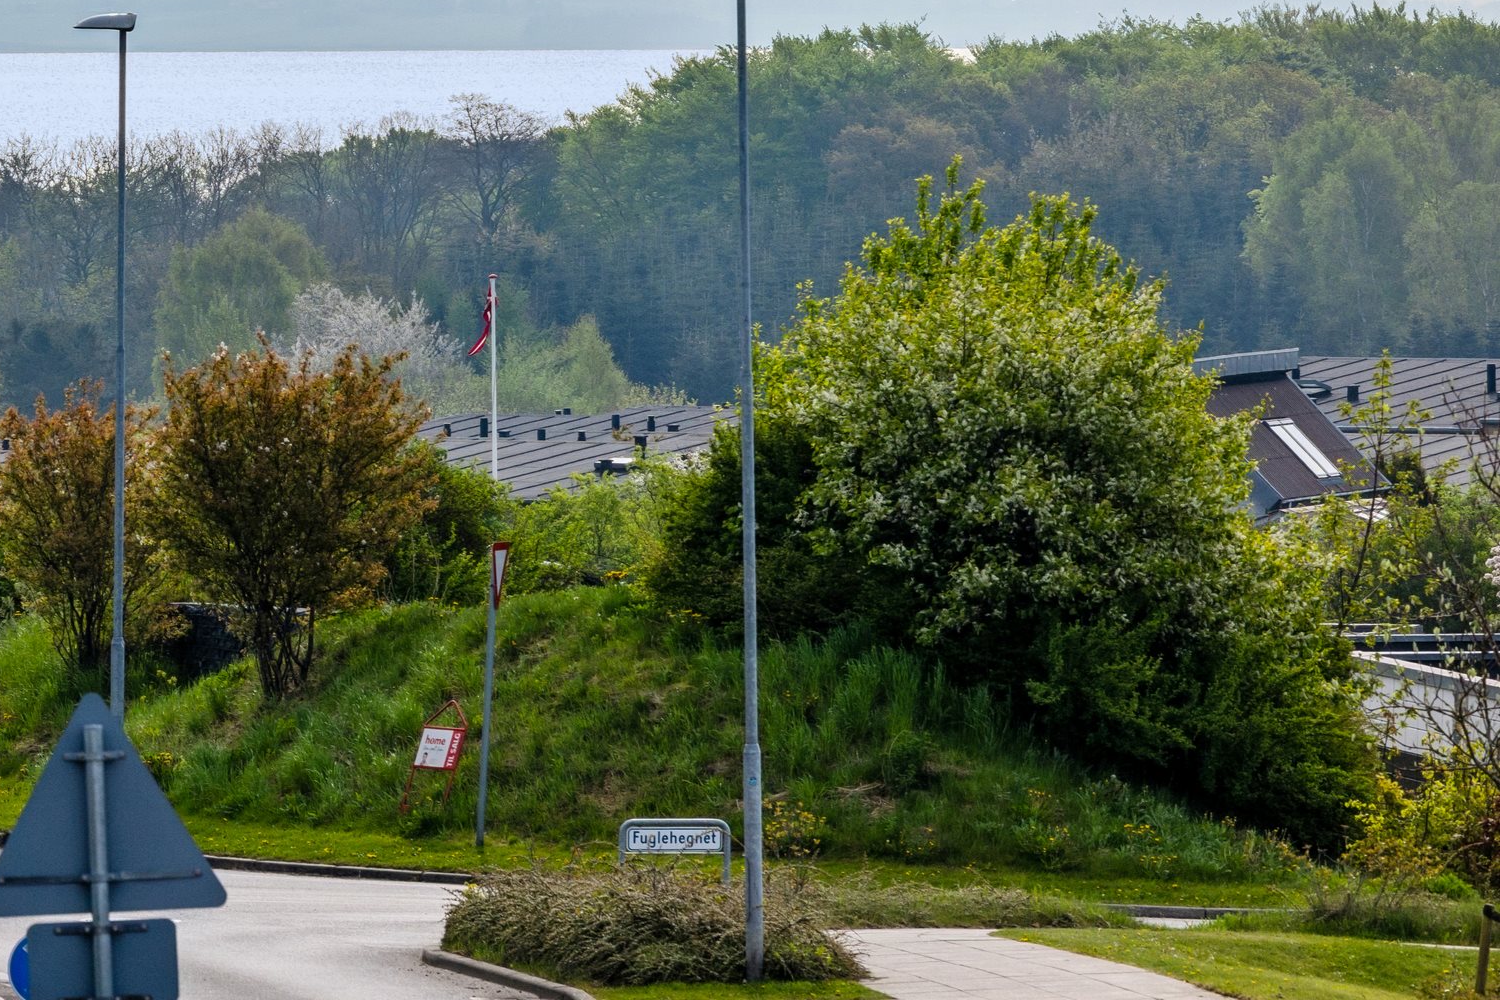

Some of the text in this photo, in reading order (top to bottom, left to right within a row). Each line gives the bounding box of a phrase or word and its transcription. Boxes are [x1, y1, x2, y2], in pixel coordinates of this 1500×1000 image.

[425, 734, 446, 746] home
[446, 733, 461, 768] TIL SALG
[632, 830, 717, 848] Fuglehegnet
